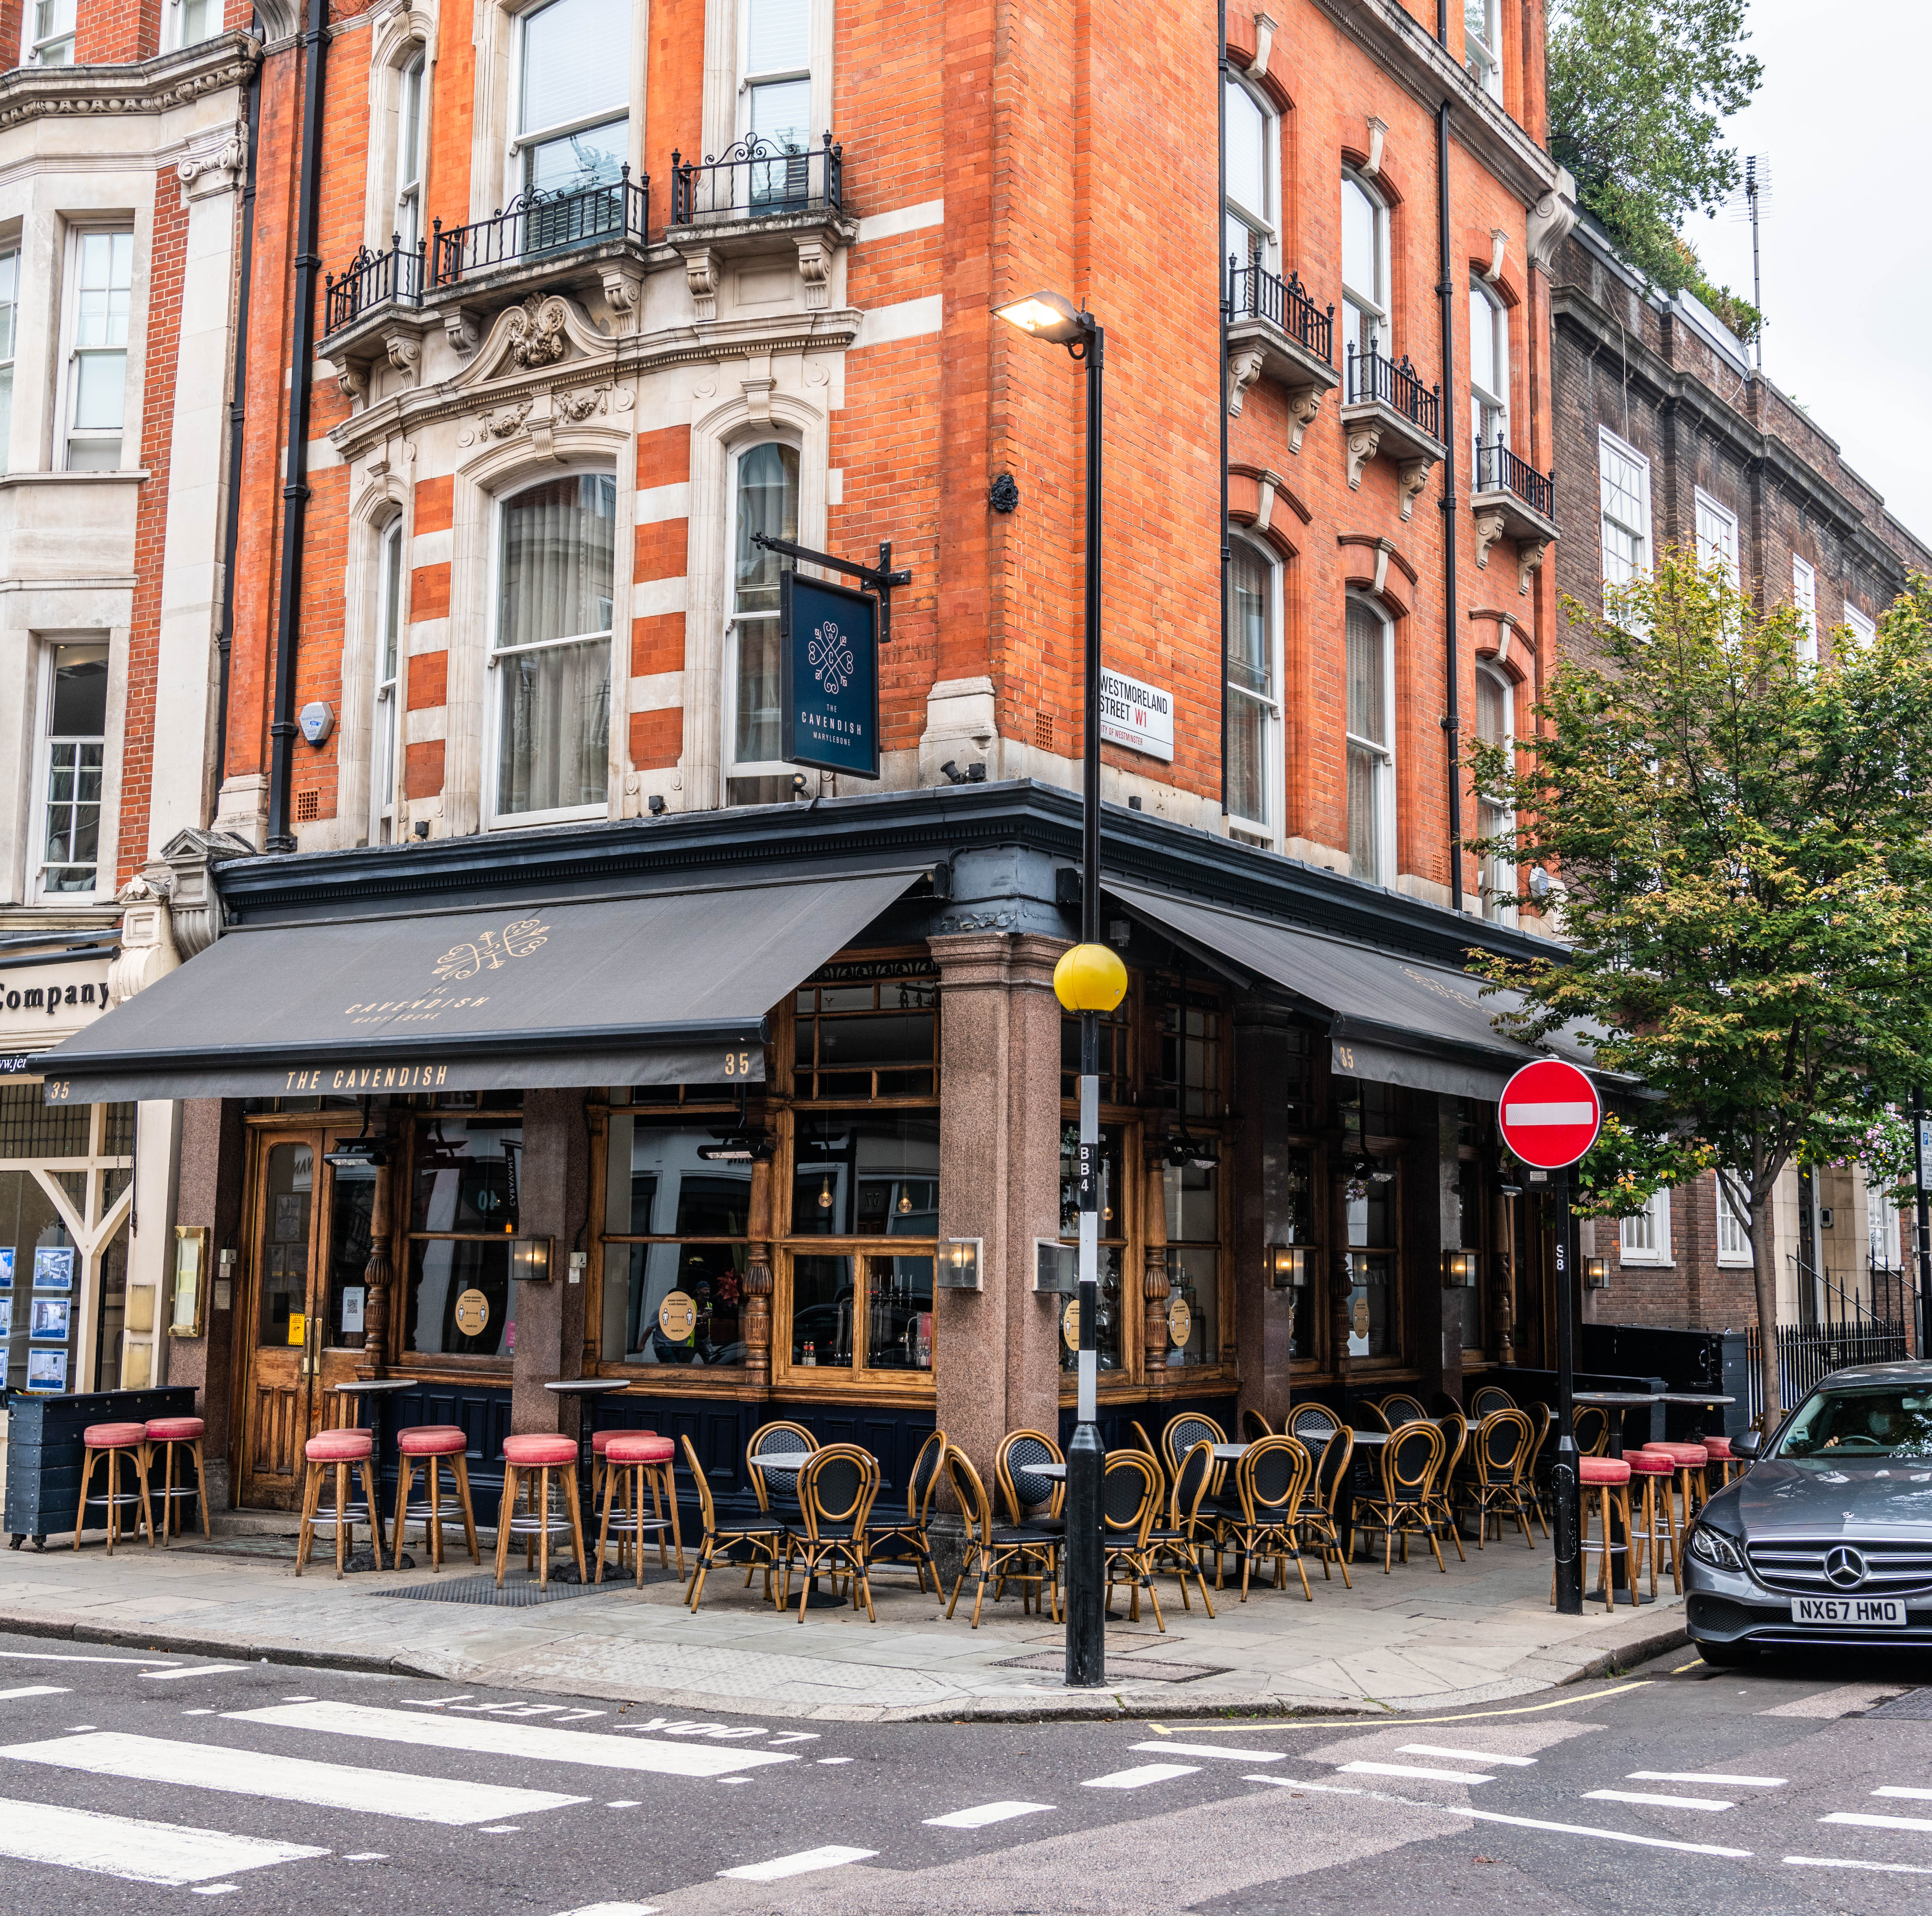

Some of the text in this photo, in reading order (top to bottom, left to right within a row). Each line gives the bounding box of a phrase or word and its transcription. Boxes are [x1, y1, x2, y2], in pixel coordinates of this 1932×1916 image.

[829, 651, 833, 664] C
[1101, 675, 1167, 714] WESTMORELAND
[827, 704, 837, 713] THE
[1101, 695, 1147, 728] STREET W1
[802, 711, 861, 735] CAVENDISH
[813, 731, 850, 746] MARYLEBONE
[1109, 727, 1114, 736] OF
[1115, 729, 1143, 746] WESTMINSTER
[345, 997, 490, 1014] CAVENDISH
[351, 1013, 441, 1023] MARYLEBONE
[725, 1053, 749, 1075] 35
[1340, 1047, 1353, 1068] 35
[286, 1066, 447, 1089] THE CAVENDISH
[51, 1081, 70, 1099] 35
[1800, 1600, 1896, 1620] NX67 HMO
[400, 1695, 821, 1745] LOOK LEFT
